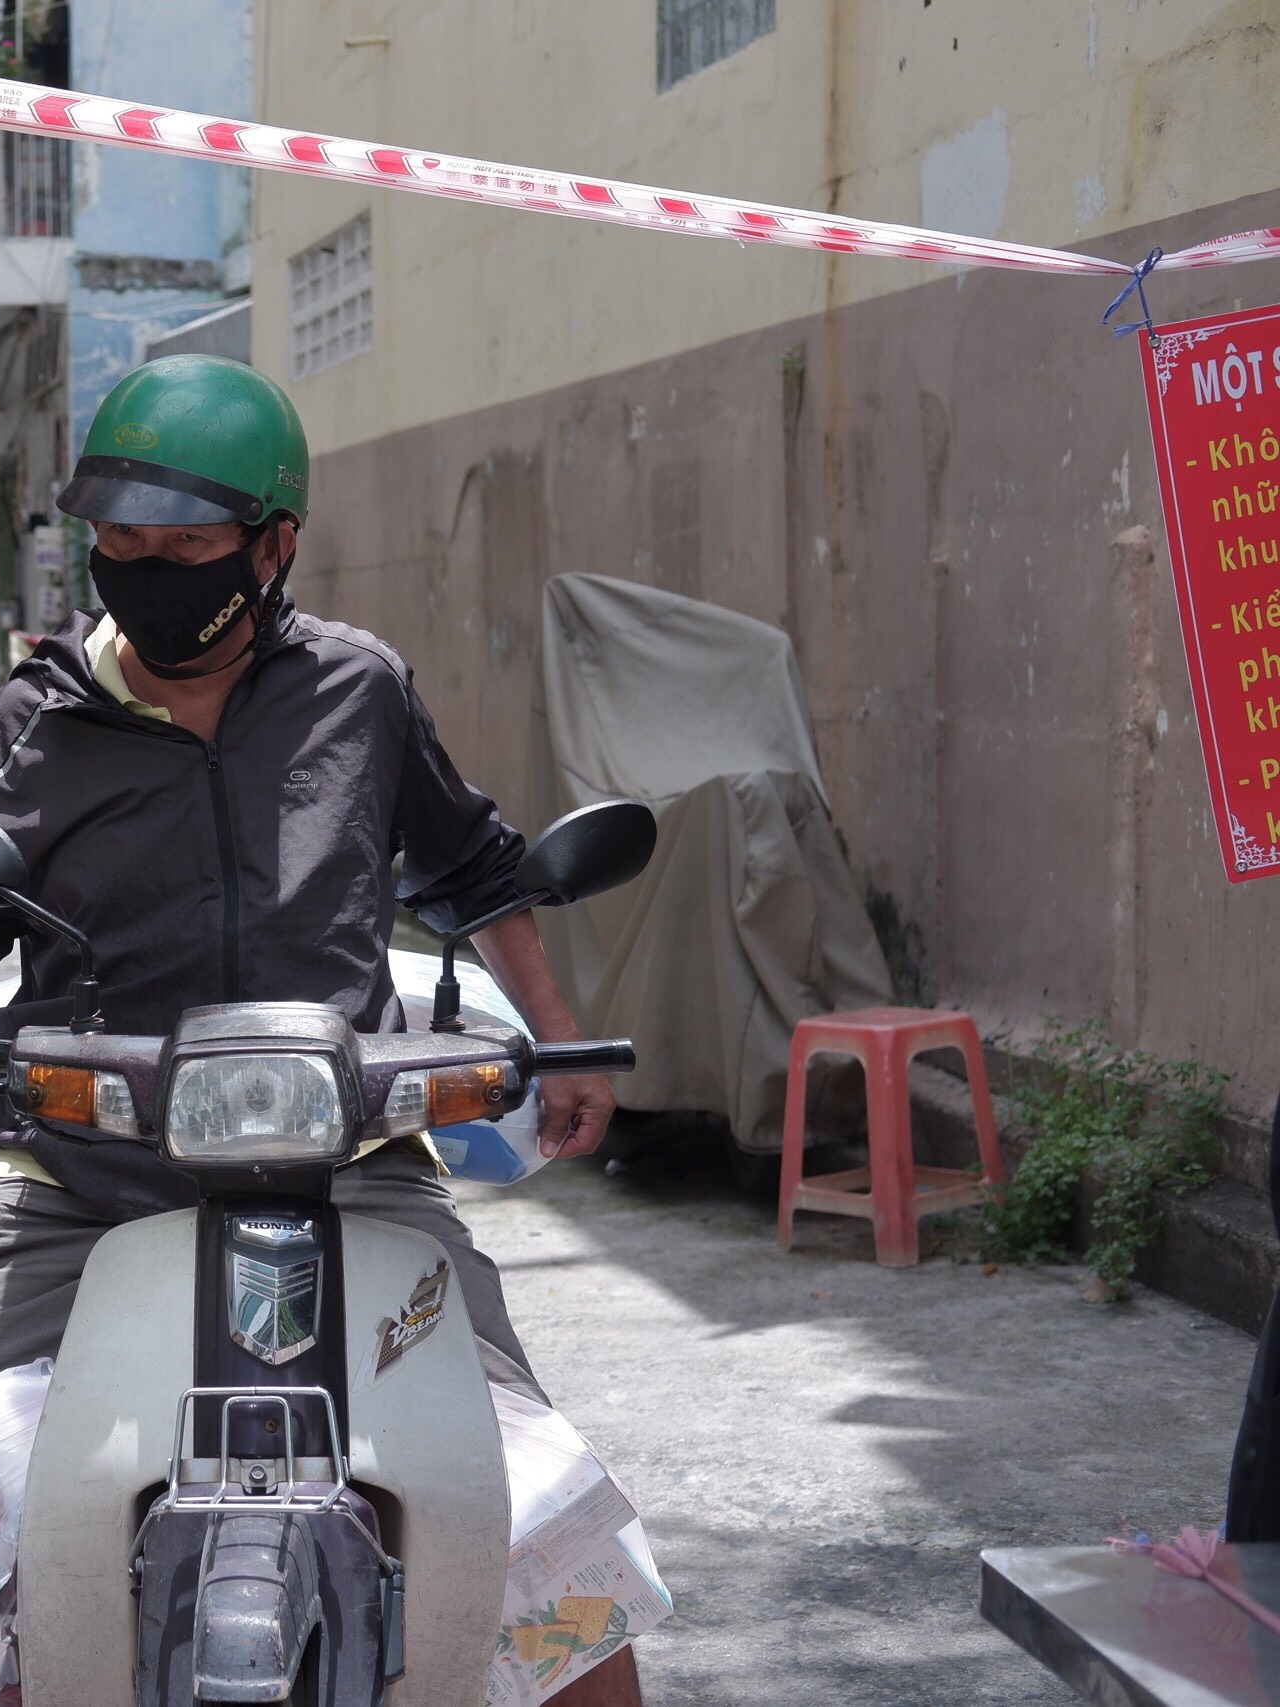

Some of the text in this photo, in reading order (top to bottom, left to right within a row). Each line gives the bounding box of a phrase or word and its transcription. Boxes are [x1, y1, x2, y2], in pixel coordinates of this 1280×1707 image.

[1192, 343, 1263, 412] MỘT
[199, 592, 246, 643] GUCCI
[283, 781, 318, 790] Kalenji
[247, 1221, 305, 1232] HONDA
[388, 1310, 445, 1350] DREAM
